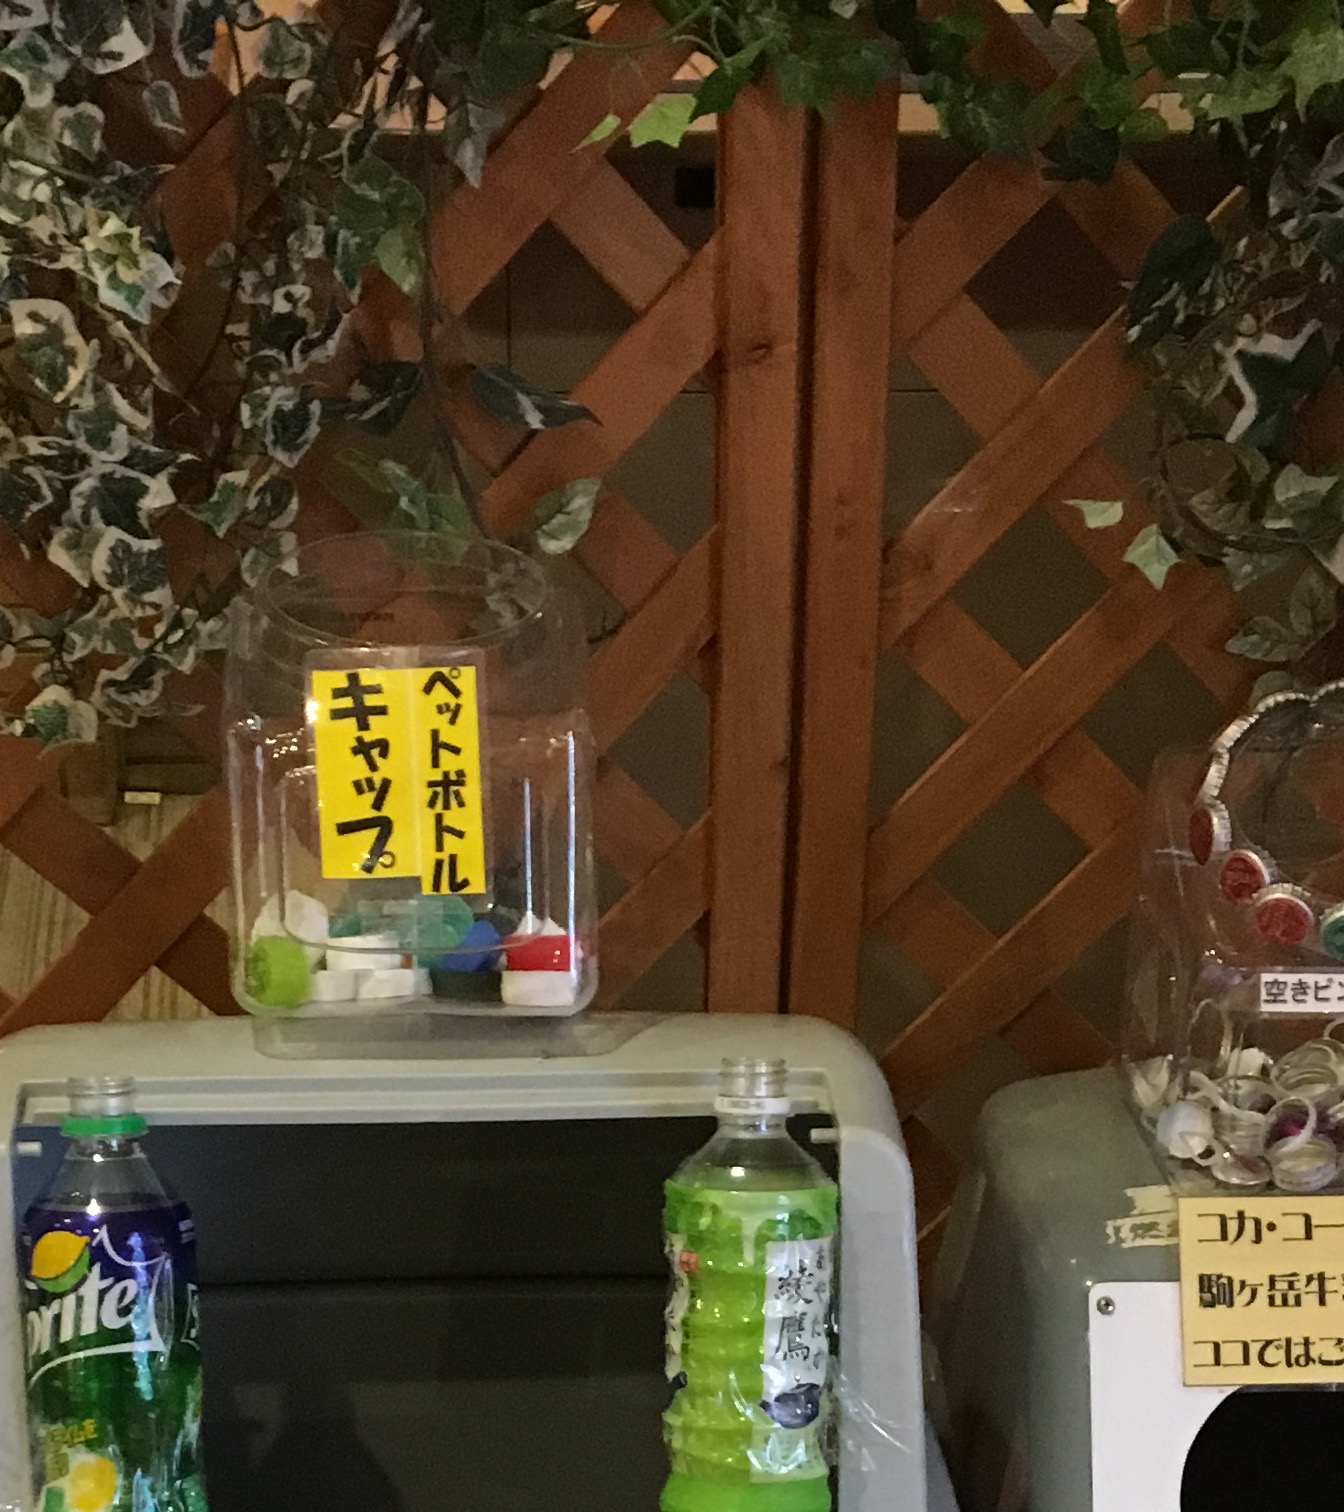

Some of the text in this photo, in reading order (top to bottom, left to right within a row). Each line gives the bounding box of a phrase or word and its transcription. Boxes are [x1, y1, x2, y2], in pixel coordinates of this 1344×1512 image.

[328, 671, 397, 874] キャップ
[422, 666, 471, 894] ペットボトル
[24, 1261, 139, 1371] prite
